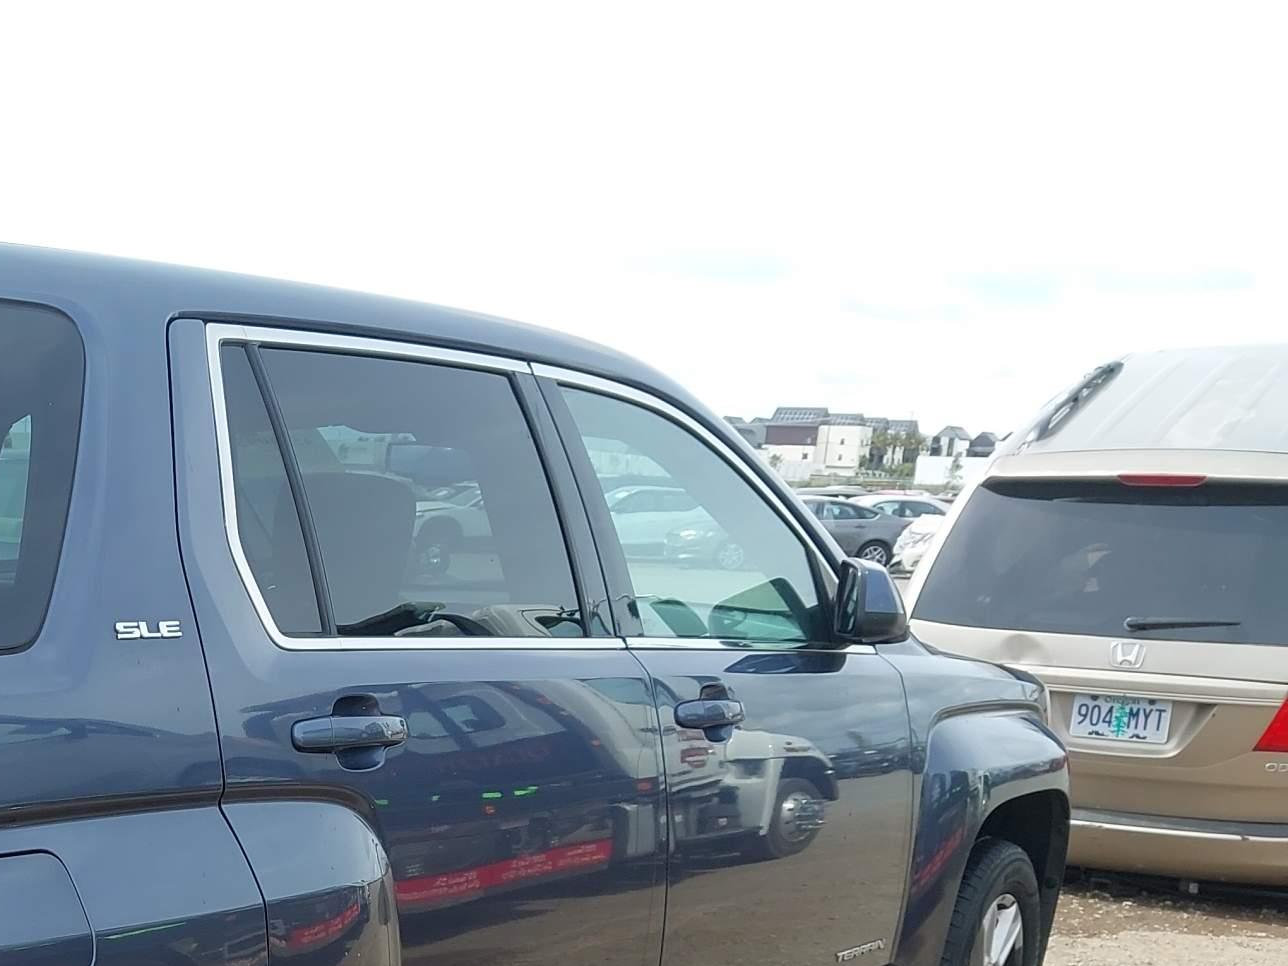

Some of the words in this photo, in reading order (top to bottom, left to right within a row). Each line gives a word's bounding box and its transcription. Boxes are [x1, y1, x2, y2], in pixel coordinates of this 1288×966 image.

[115, 620, 183, 640] SLE
[1077, 703, 1114, 728] 904
[1127, 706, 1167, 732] MYT
